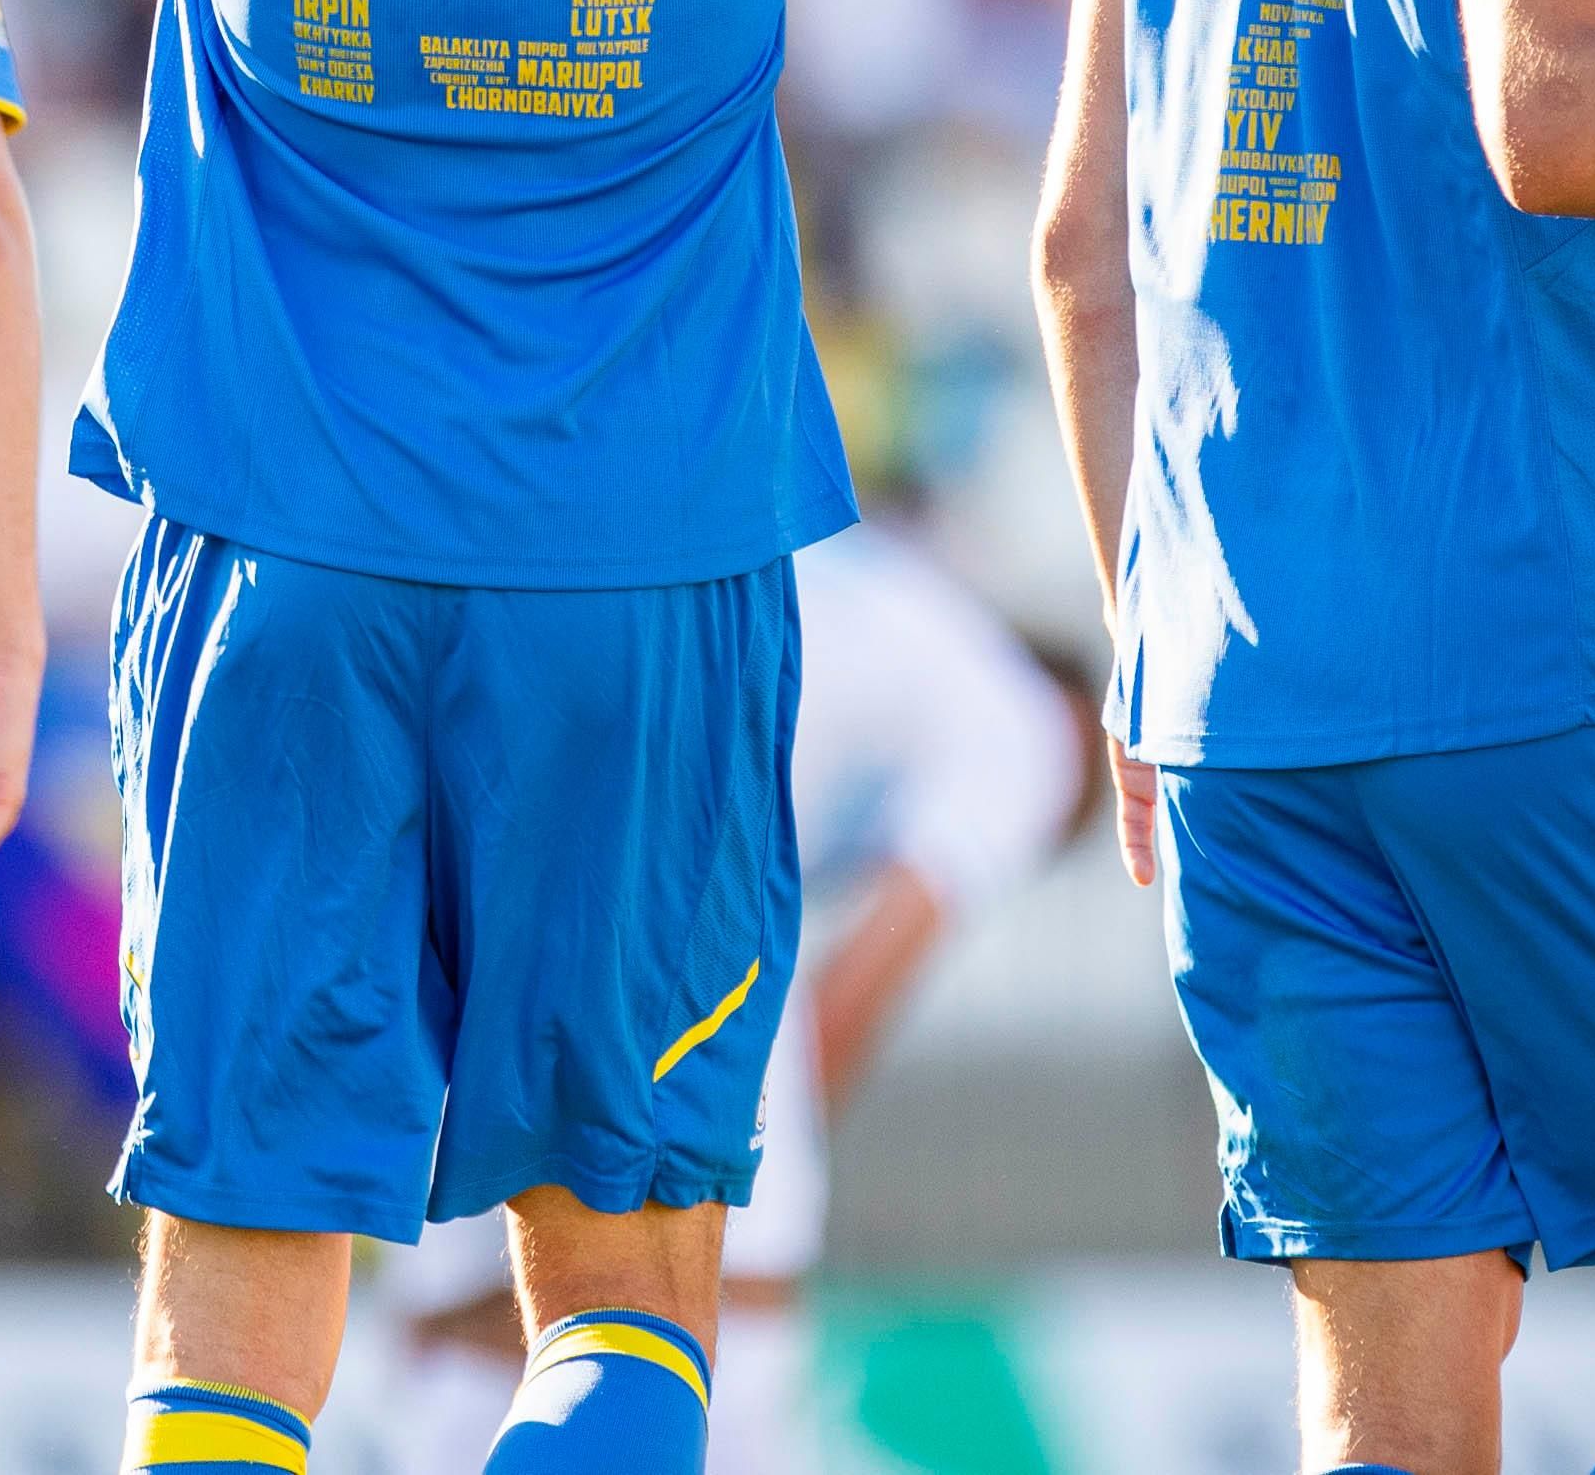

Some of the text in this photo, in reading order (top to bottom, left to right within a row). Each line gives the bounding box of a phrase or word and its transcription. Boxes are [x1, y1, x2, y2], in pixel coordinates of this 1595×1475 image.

[294, 22, 372, 48] OKHTYRKA
[570, 6, 653, 36] LUTSK
[420, 35, 510, 58] BALAKLIYA
[518, 41, 567, 58] DNIPRO
[328, 60, 374, 81] ODESA
[518, 59, 644, 93] MARIUPOL
[300, 74, 375, 104] KHARKIV
[446, 86, 614, 118] CHORNOBAIVKA
[1226, 110, 1284, 151] YIV
